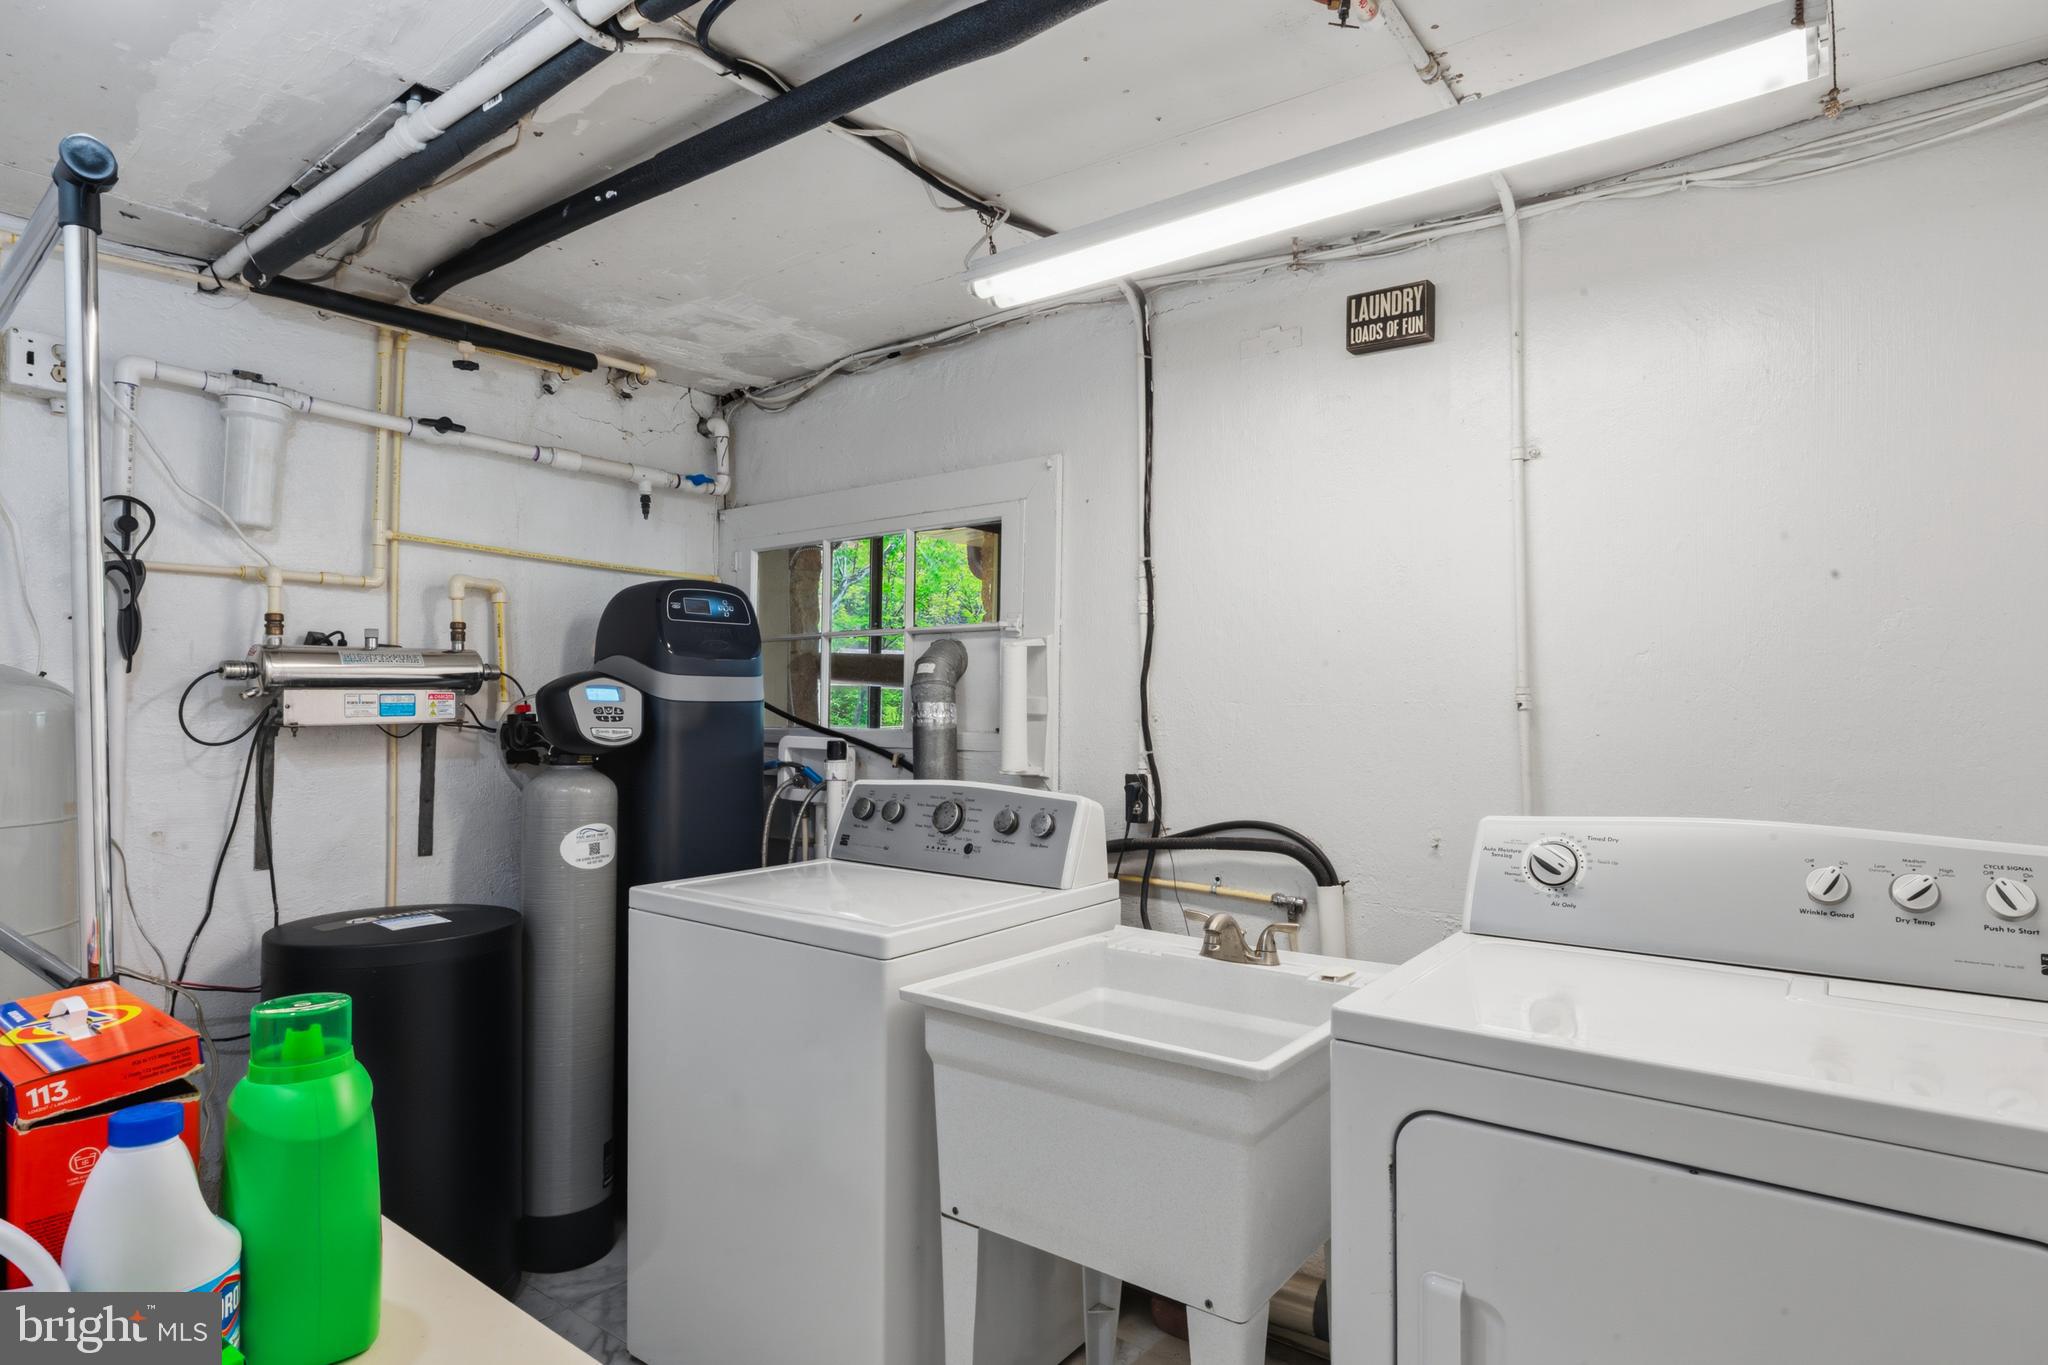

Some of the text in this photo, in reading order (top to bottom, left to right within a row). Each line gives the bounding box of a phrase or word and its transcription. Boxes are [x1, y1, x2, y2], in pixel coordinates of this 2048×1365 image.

[1351, 285, 1424, 323] LAUNDRY
[1350, 314, 1424, 344] LOADS OF FUN
[1799, 908, 1855, 919] Wrinkle Guard
[1895, 916, 1936, 927] Dry Temp
[1984, 924, 2005, 933] Push
[2018, 927, 2040, 936] Start
[25, 1079, 69, 1109] 113
